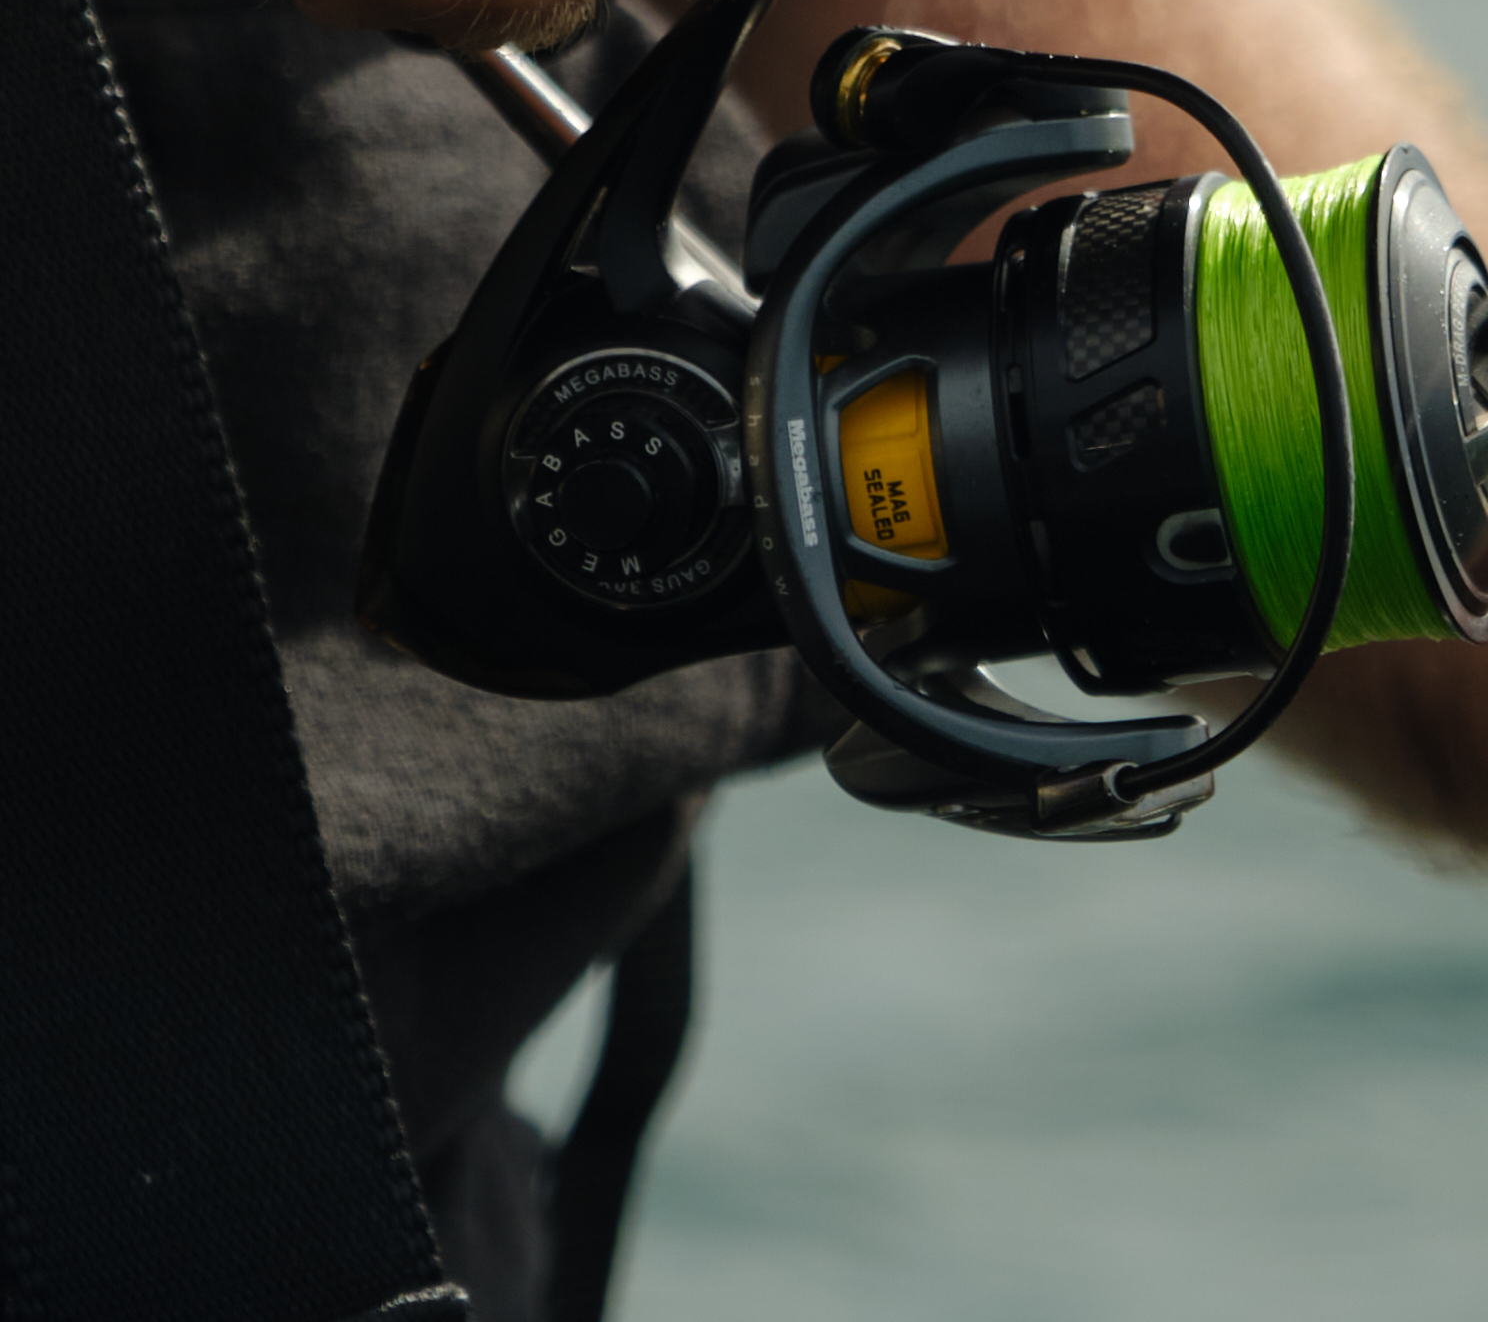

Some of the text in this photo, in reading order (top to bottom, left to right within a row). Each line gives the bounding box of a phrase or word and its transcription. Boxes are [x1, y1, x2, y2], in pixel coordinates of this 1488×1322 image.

[553, 362, 679, 404] MEGABASS
[787, 419, 819, 547] Megabass
[863, 469, 895, 540] SEALED
[887, 481, 911, 523] MAG
